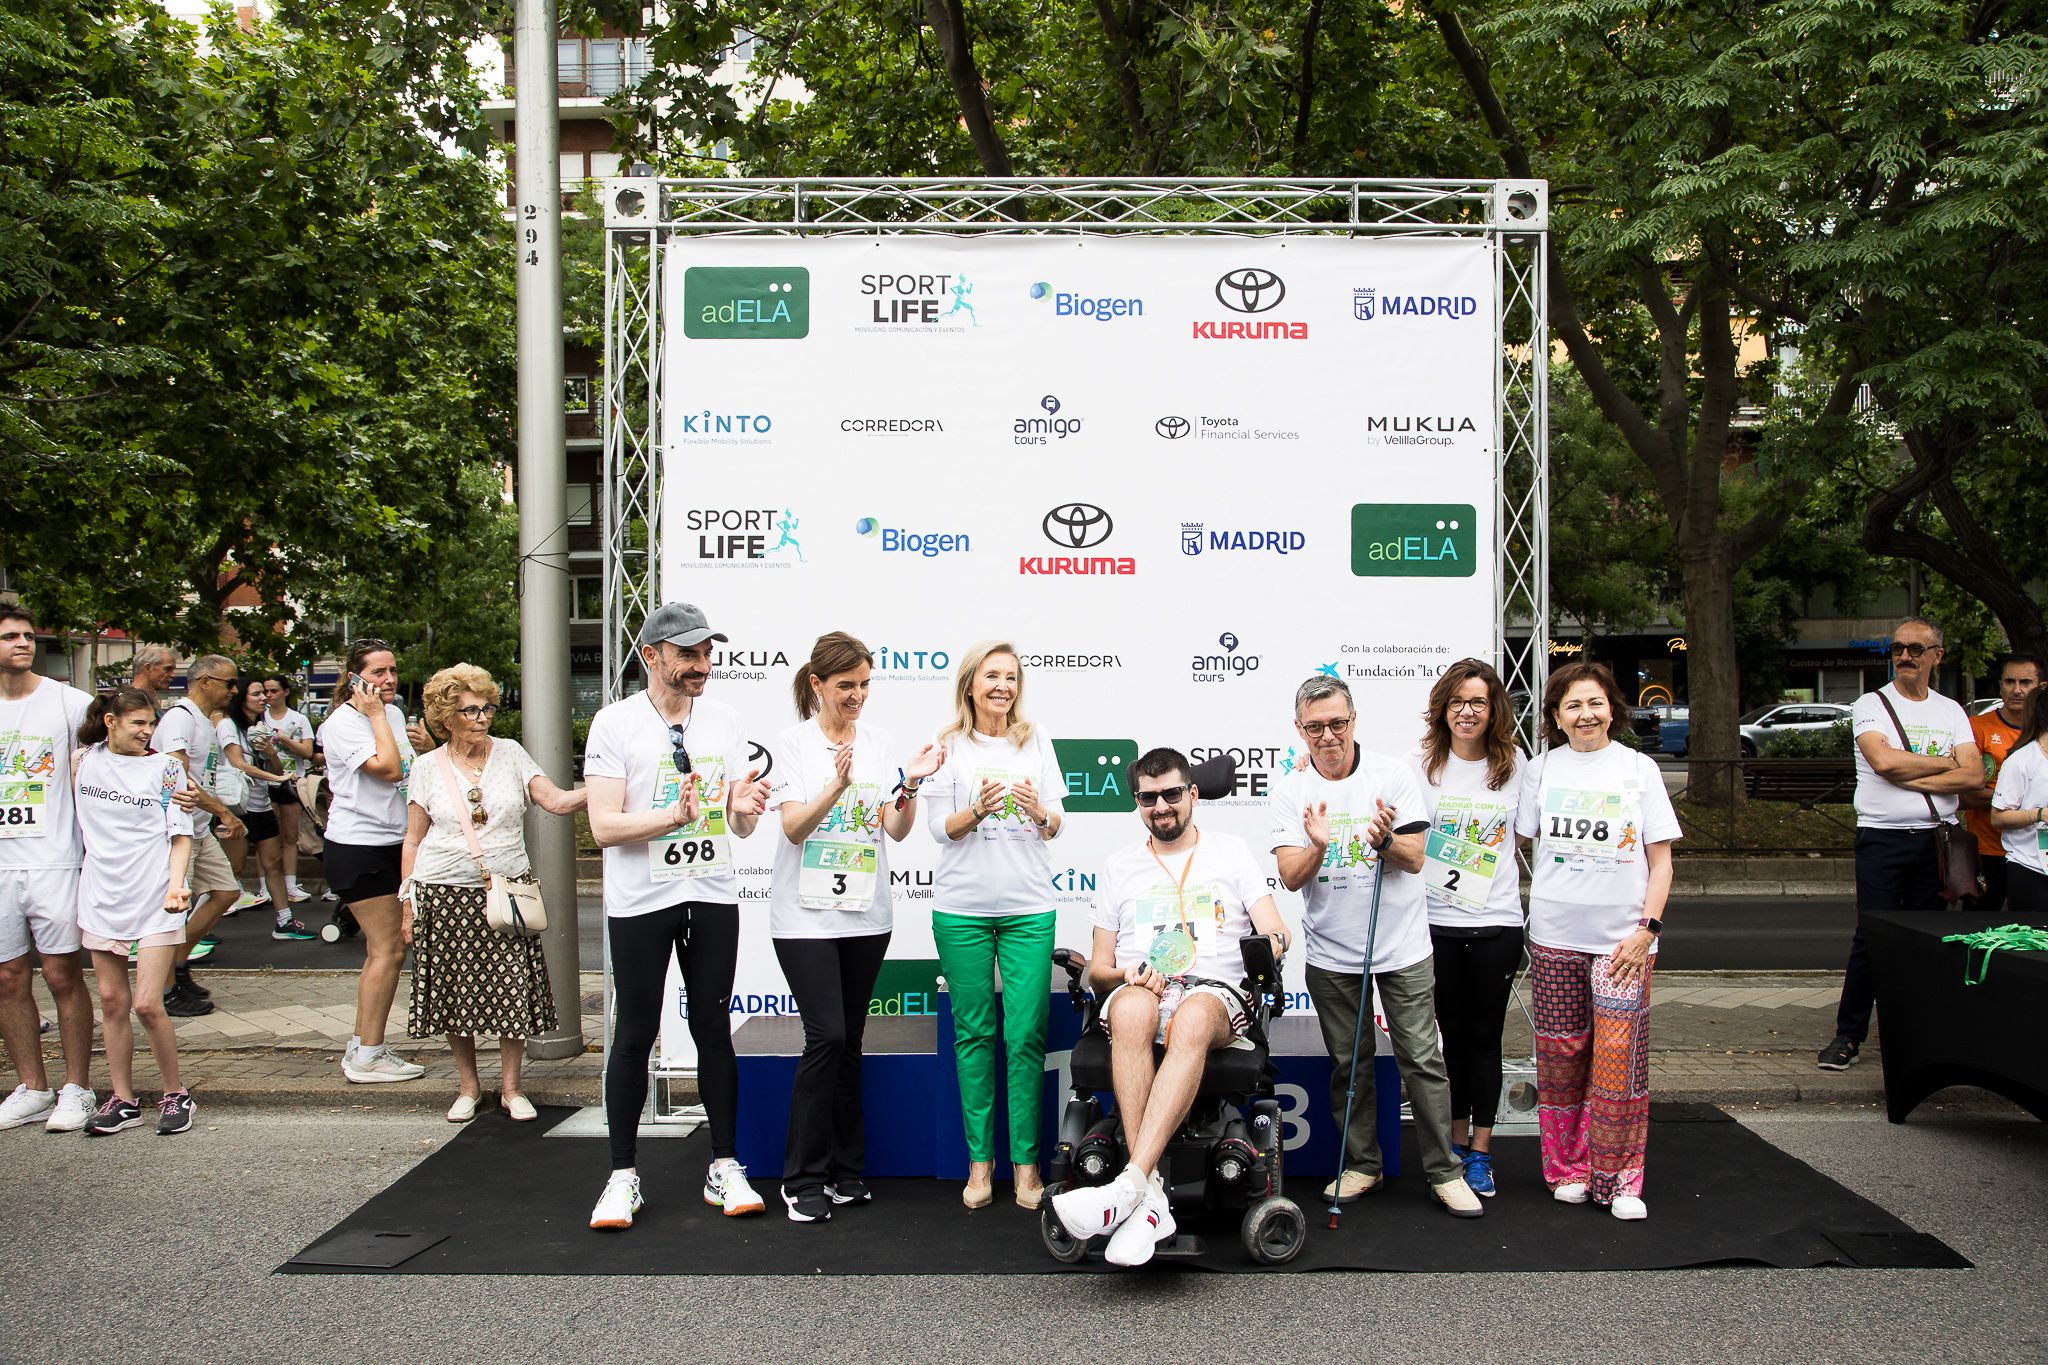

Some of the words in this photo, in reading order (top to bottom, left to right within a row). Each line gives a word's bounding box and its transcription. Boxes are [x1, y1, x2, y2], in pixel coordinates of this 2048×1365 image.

[861, 275, 951, 295] SPORT
[702, 300, 791, 323] adELA
[874, 300, 938, 323] LIFE
[1056, 293, 1142, 321] Biogen
[1383, 297, 1476, 320] MADRID
[1014, 418, 1080, 439] amigo
[1201, 417, 1238, 428] Toyota
[1368, 417, 1476, 431] MUKUA
[712, 438, 738, 446] Mobility
[1014, 436, 1046, 445] tours
[1201, 430, 1250, 440] Financial
[1254, 430, 1300, 440] Services
[1367, 436, 1380, 446] by
[1384, 436, 1454, 446] VelillaGroup.
[687, 510, 777, 530] SPORT
[700, 536, 764, 558] LIFE
[883, 529, 969, 557] Biogen
[1211, 531, 1305, 554] MADRID
[1369, 537, 1458, 560] adELA
[712, 652, 789, 666] UKUA
[1341, 645, 1359, 653] Con
[1362, 645, 1370, 653] la
[1373, 644, 1432, 653] colaboración
[1436, 645, 1450, 653] de:
[1192, 656, 1259, 676] amigo
[1348, 664, 1414, 676] Fundación
[1193, 673, 1224, 682] tours
[1066, 773, 1120, 795] ELA
[1231, 774, 1267, 796] FE
[80, 784, 153, 808] elillaGroup.
[1550, 816, 1608, 841] 1198
[664, 840, 715, 865] 698
[832, 874, 847, 895] 3
[1444, 870, 1460, 891] 2
[730, 995, 800, 1016] ADRID
[868, 993, 938, 1015] adEL
[1274, 1083, 1310, 1150] 3
